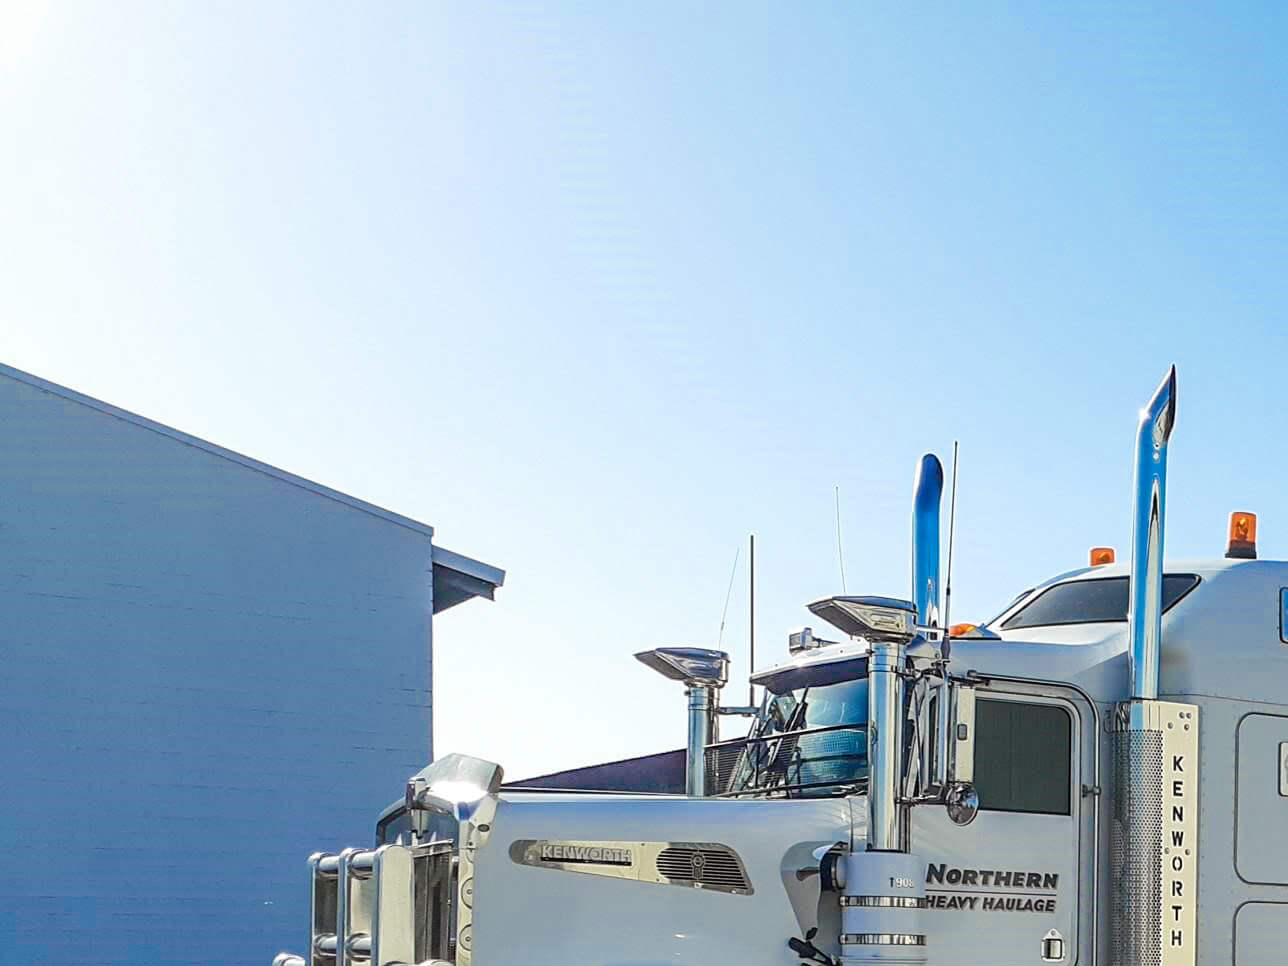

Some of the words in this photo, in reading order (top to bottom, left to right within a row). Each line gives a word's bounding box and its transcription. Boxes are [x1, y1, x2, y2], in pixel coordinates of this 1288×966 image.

[542, 845, 632, 862] KENWORTH
[1171, 756, 1184, 946] KENWORTH
[925, 895, 978, 911] HEAVY
[982, 897, 1057, 912] HAULAGE
